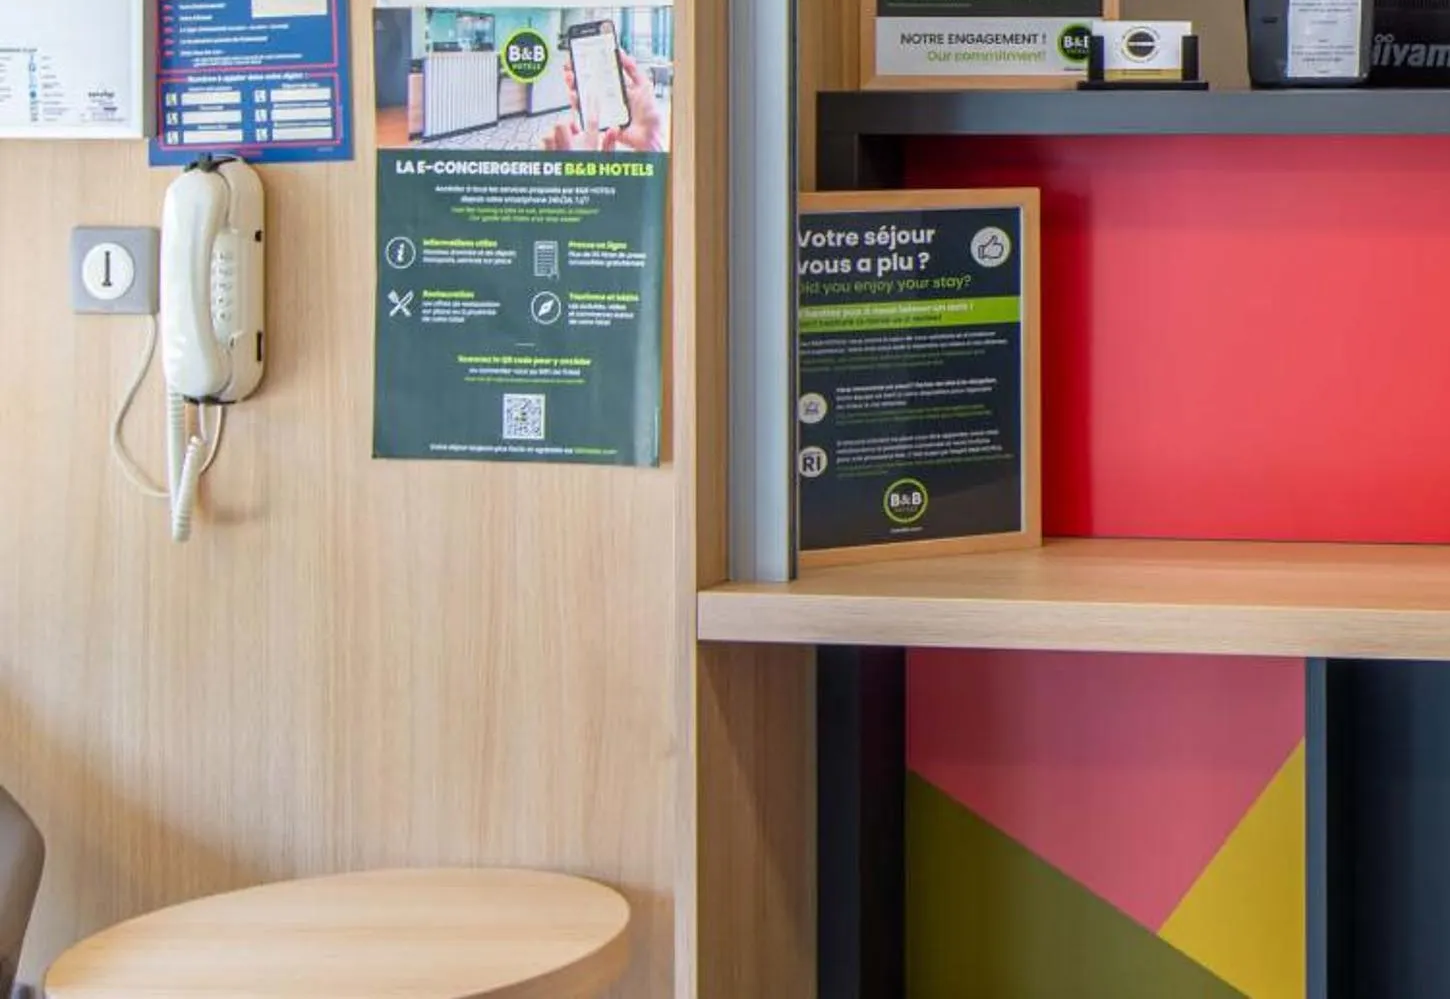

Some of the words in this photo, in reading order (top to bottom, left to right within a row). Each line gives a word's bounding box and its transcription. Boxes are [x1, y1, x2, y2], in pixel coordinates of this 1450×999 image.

[900, 33, 944, 45] NOTRE
[947, 33, 1038, 45] ENGAGEMENT
[508, 45, 545, 62] B&B
[927, 50, 951, 63] Our
[396, 160, 415, 175] LA
[416, 160, 542, 176] E-CONCIERGERIE
[543, 162, 563, 176] DE
[564, 162, 598, 176] B&B
[599, 163, 654, 177] HOTELS
[799, 229, 860, 248] Votre
[863, 225, 937, 250] séjour
[799, 258, 852, 275] vous
[856, 257, 871, 273] a
[877, 253, 914, 277] plu
[918, 252, 931, 270] ?
[823, 281, 850, 296] you
[854, 278, 893, 296] enjoy
[898, 278, 930, 292] your
[933, 274, 972, 289] stay?
[890, 491, 922, 508] B&B
